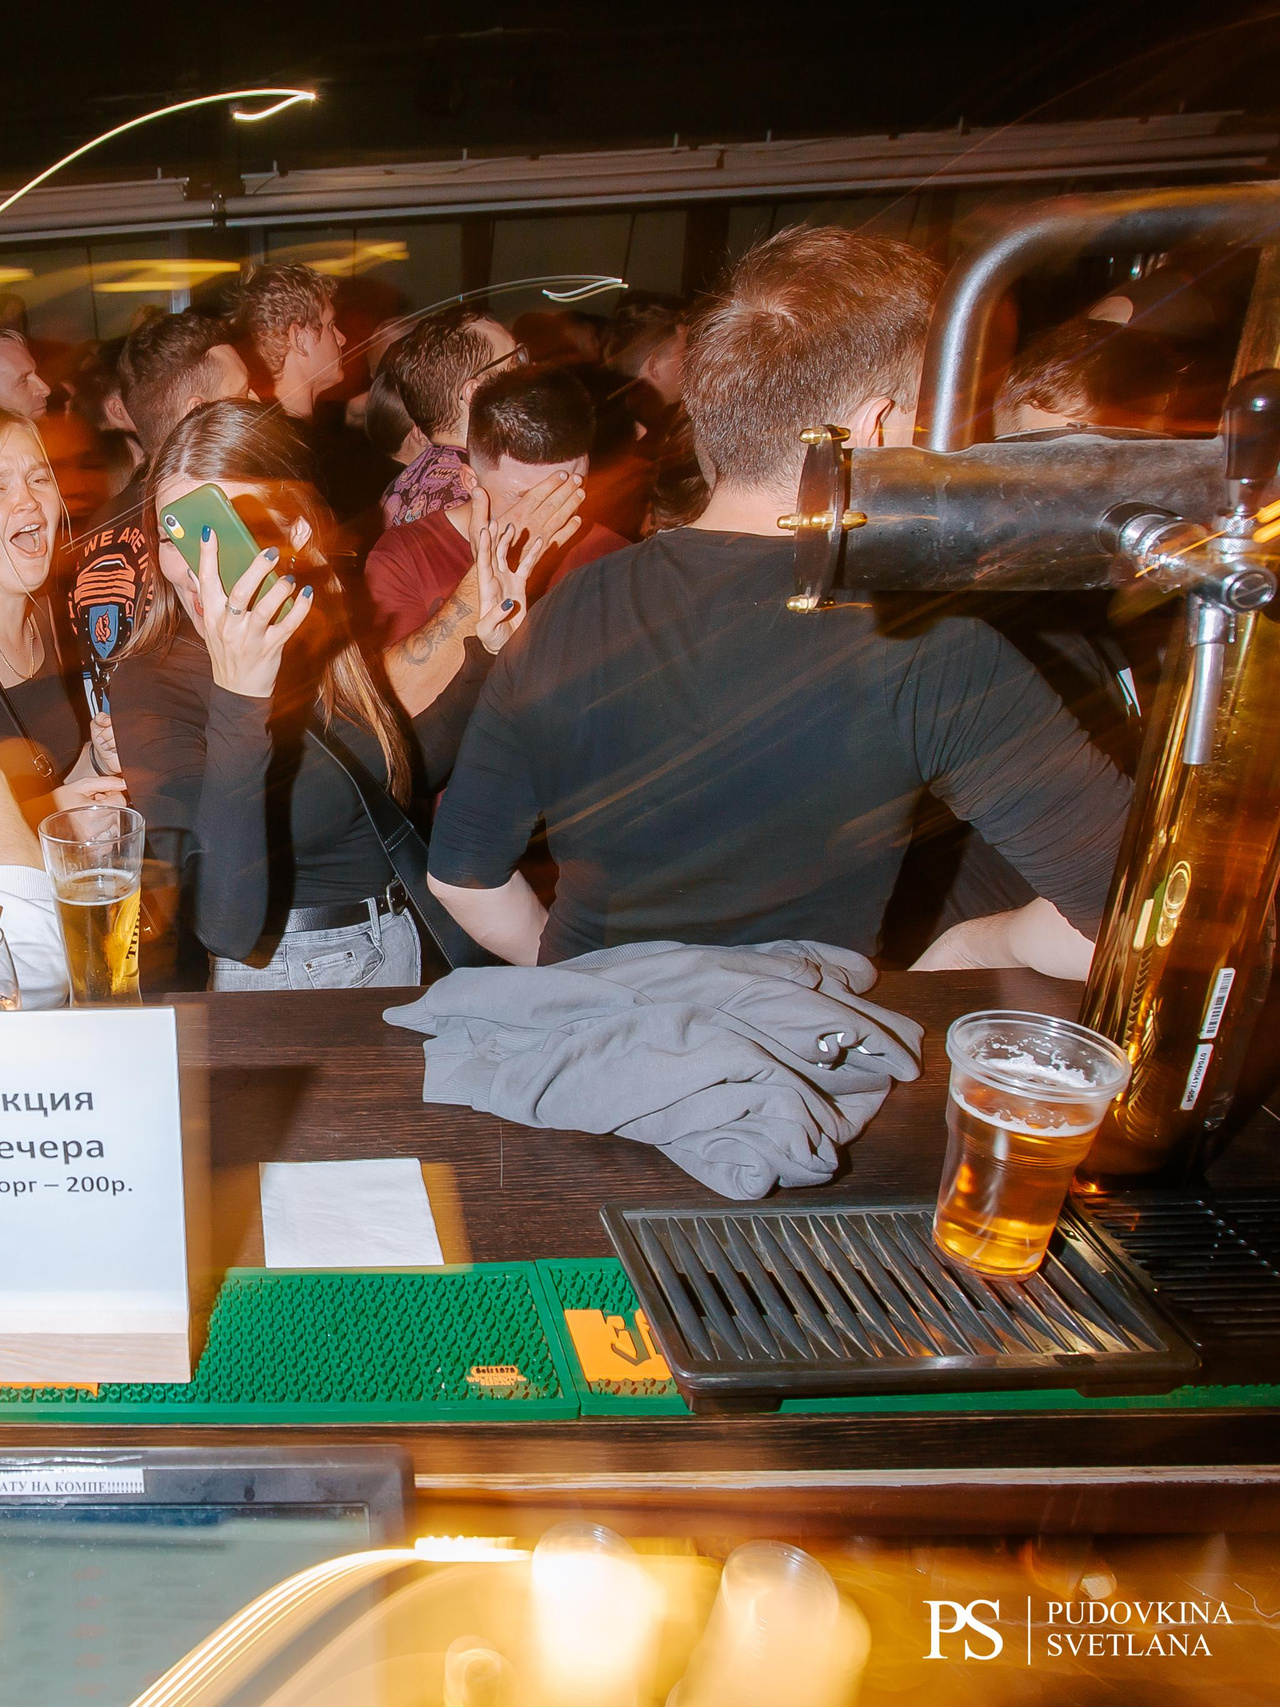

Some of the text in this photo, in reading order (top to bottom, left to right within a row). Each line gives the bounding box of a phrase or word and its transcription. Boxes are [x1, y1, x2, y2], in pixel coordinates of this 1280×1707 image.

[84, 526, 146, 557] WE ARE
[65, 1175, 133, 1196] 200р.
[31, 1481, 54, 1493] НА
